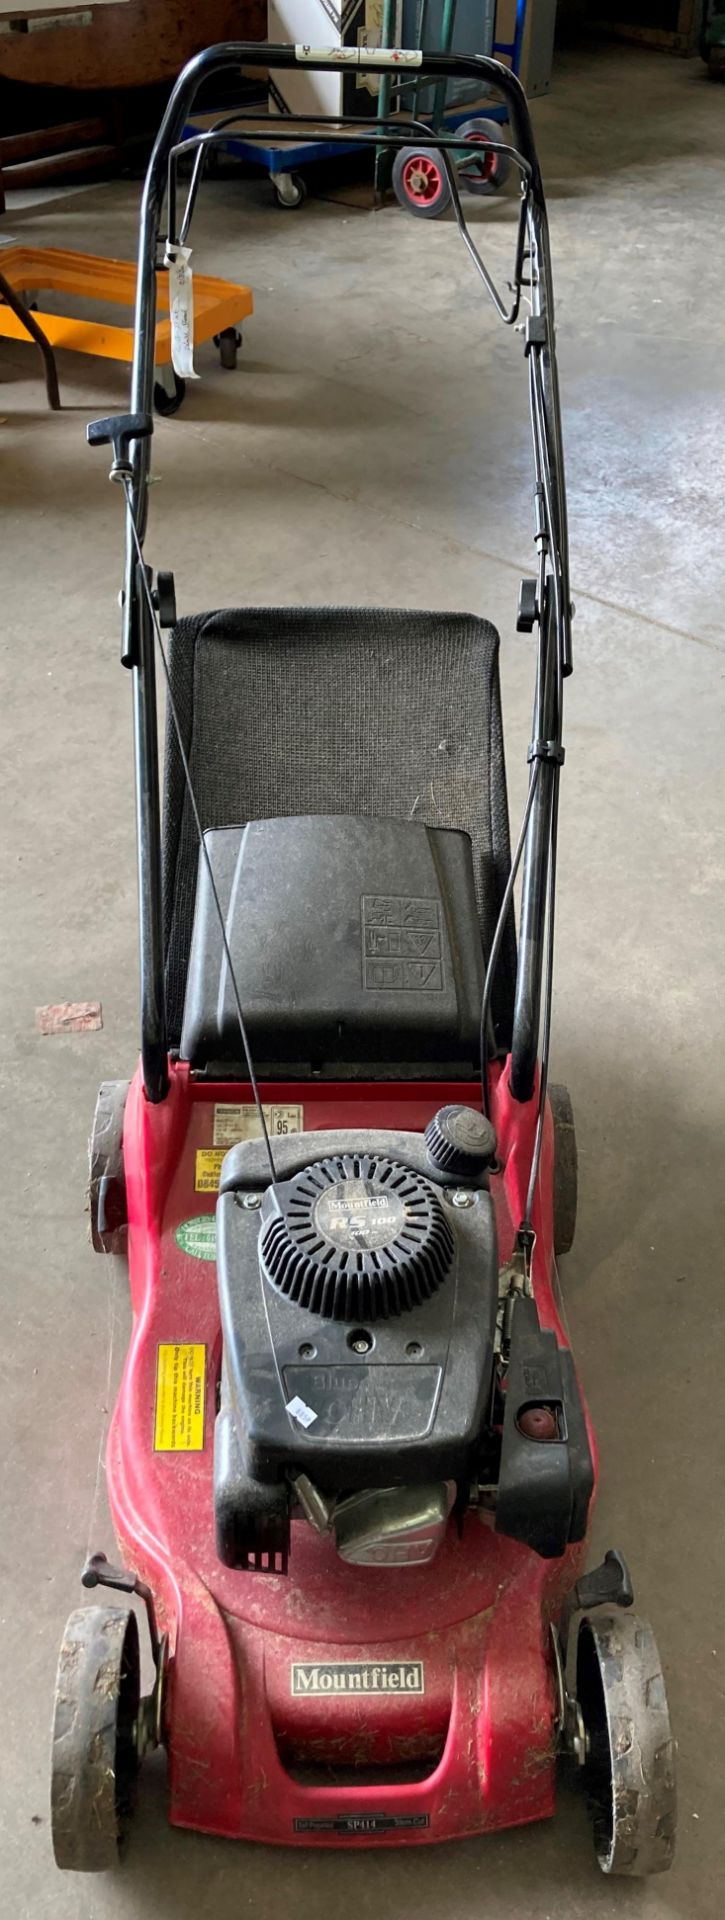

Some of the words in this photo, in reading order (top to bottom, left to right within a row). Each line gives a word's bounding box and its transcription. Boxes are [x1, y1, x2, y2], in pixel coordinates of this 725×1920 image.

[277, 1120, 288, 1135] 95
[329, 1198, 387, 1210] Mountfield
[329, 1215, 367, 1230] RS
[371, 1215, 397, 1225] 100
[296, 1667, 420, 1690] Mountfield
[346, 1819, 376, 1830] SP414
